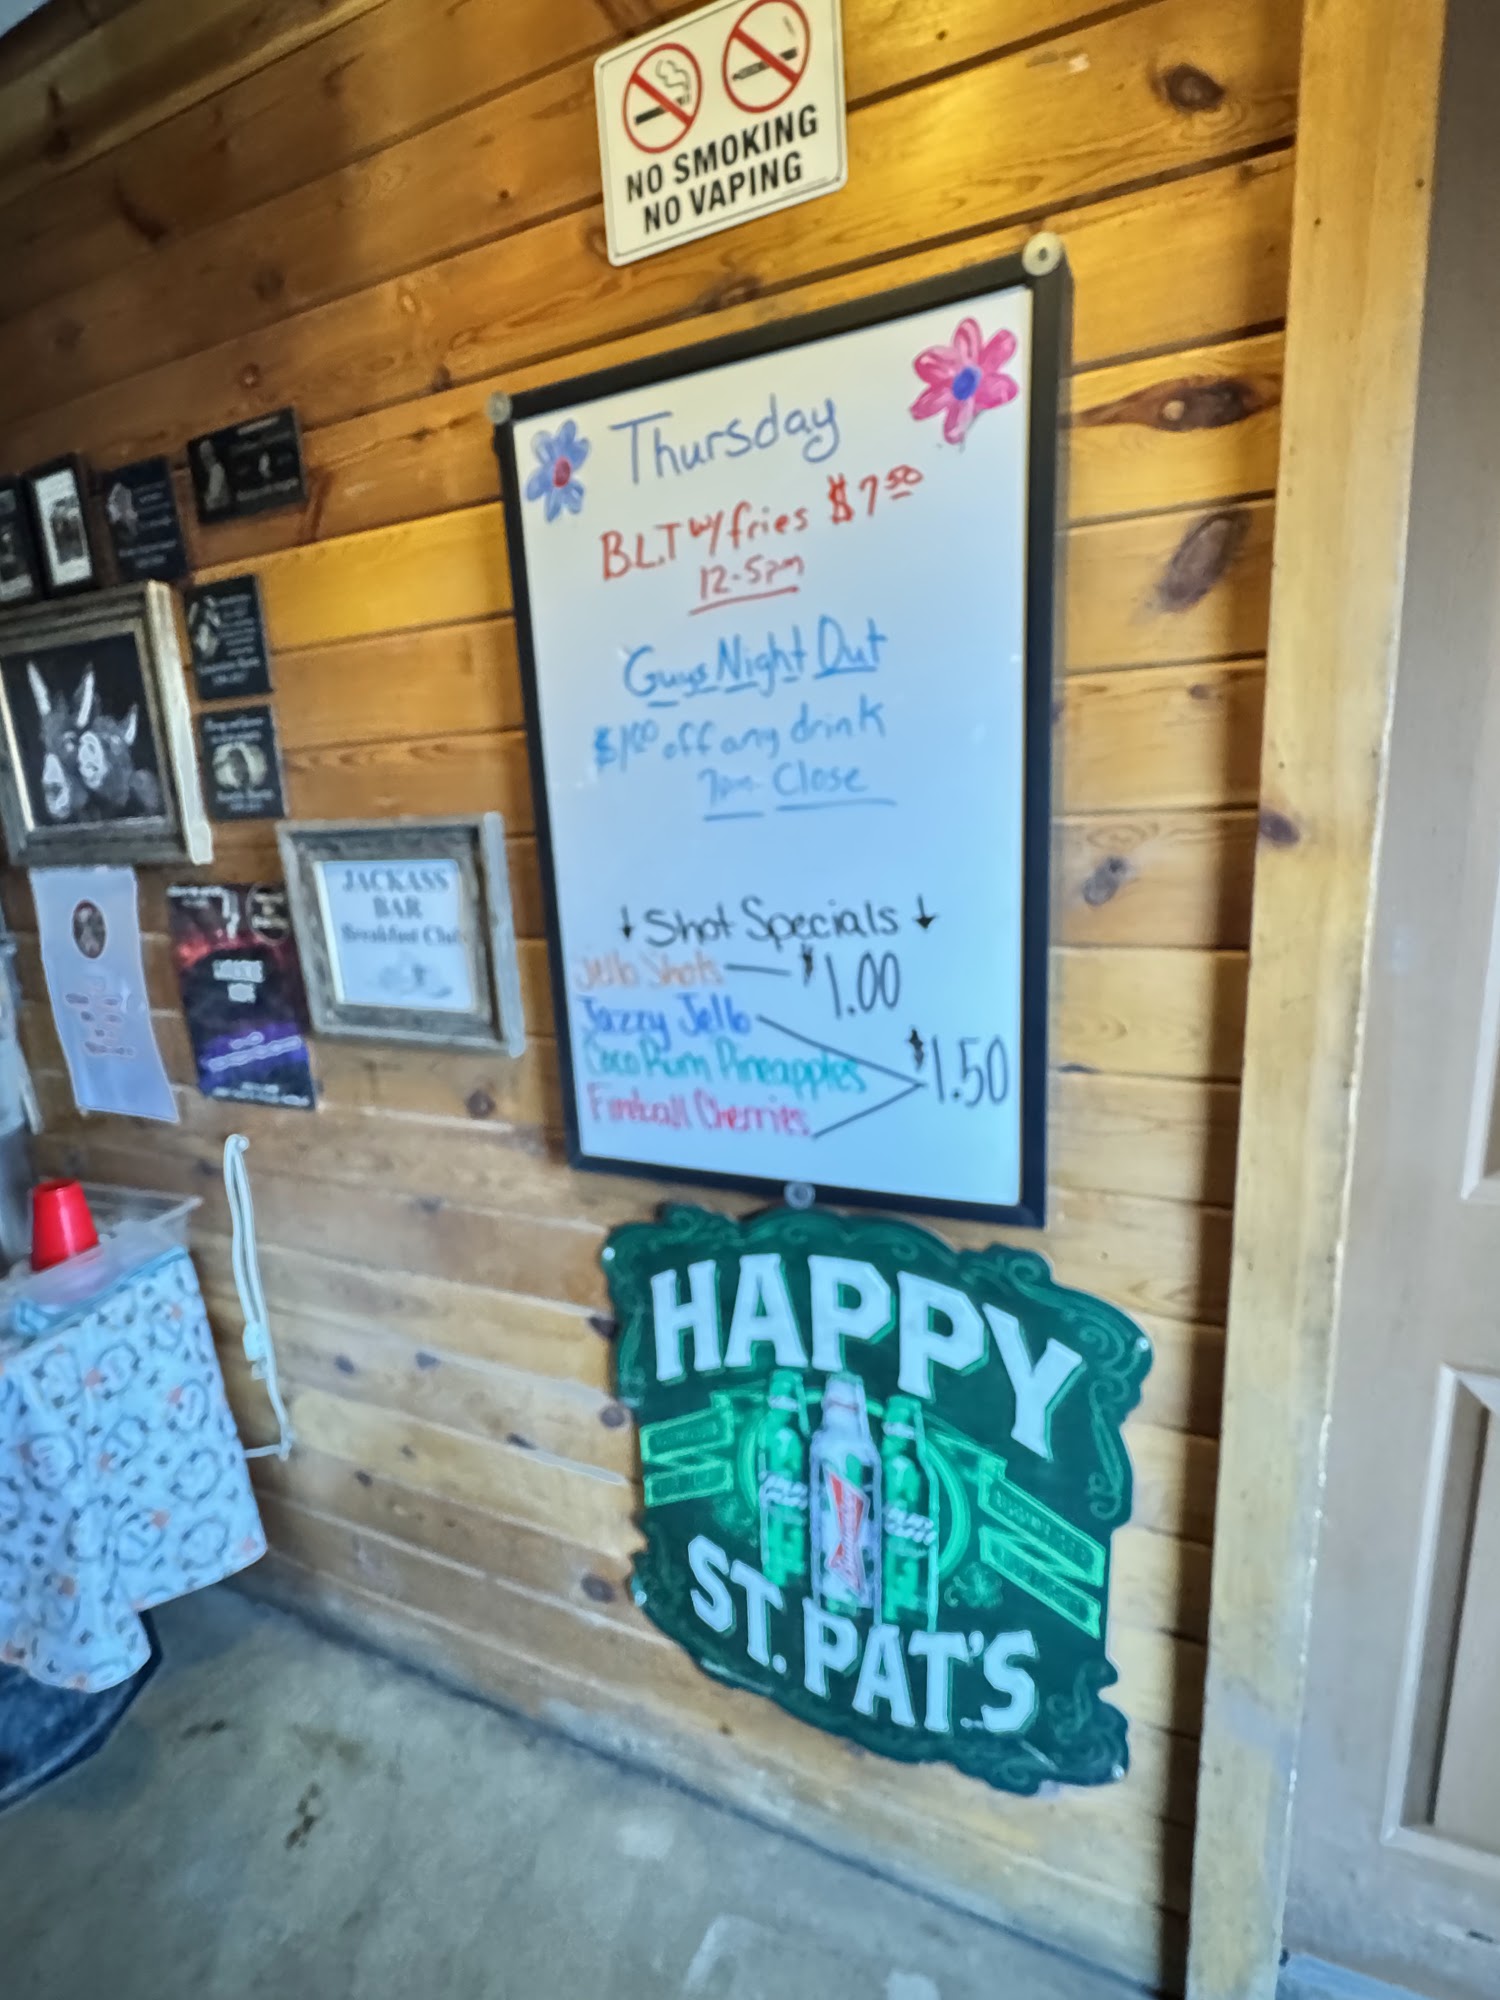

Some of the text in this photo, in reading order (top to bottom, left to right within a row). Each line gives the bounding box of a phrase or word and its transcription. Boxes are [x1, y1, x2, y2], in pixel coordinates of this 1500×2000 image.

[626, 104, 818, 202] NO SMOKING
[643, 195, 681, 235] NO
[689, 151, 803, 217] VAPING
[608, 393, 841, 484] Thursday
[727, 500, 808, 550] fries
[623, 614, 889, 699] Guys Night Out
[662, 719, 715, 760] off
[790, 693, 887, 745] drink
[773, 760, 869, 797] Close
[342, 868, 449, 893] JACKASS
[643, 895, 900, 952] Shot Specials
[577, 991, 752, 1051] Jazzy Jello
[800, 942, 902, 1021] $1.00
[638, 1033, 712, 1083] Rum
[908, 1024, 1010, 1109] $1.50
[651, 1252, 1084, 1461] HAPPY
[687, 1534, 787, 1674] ST.
[802, 1595, 1040, 1735] PAT'S
